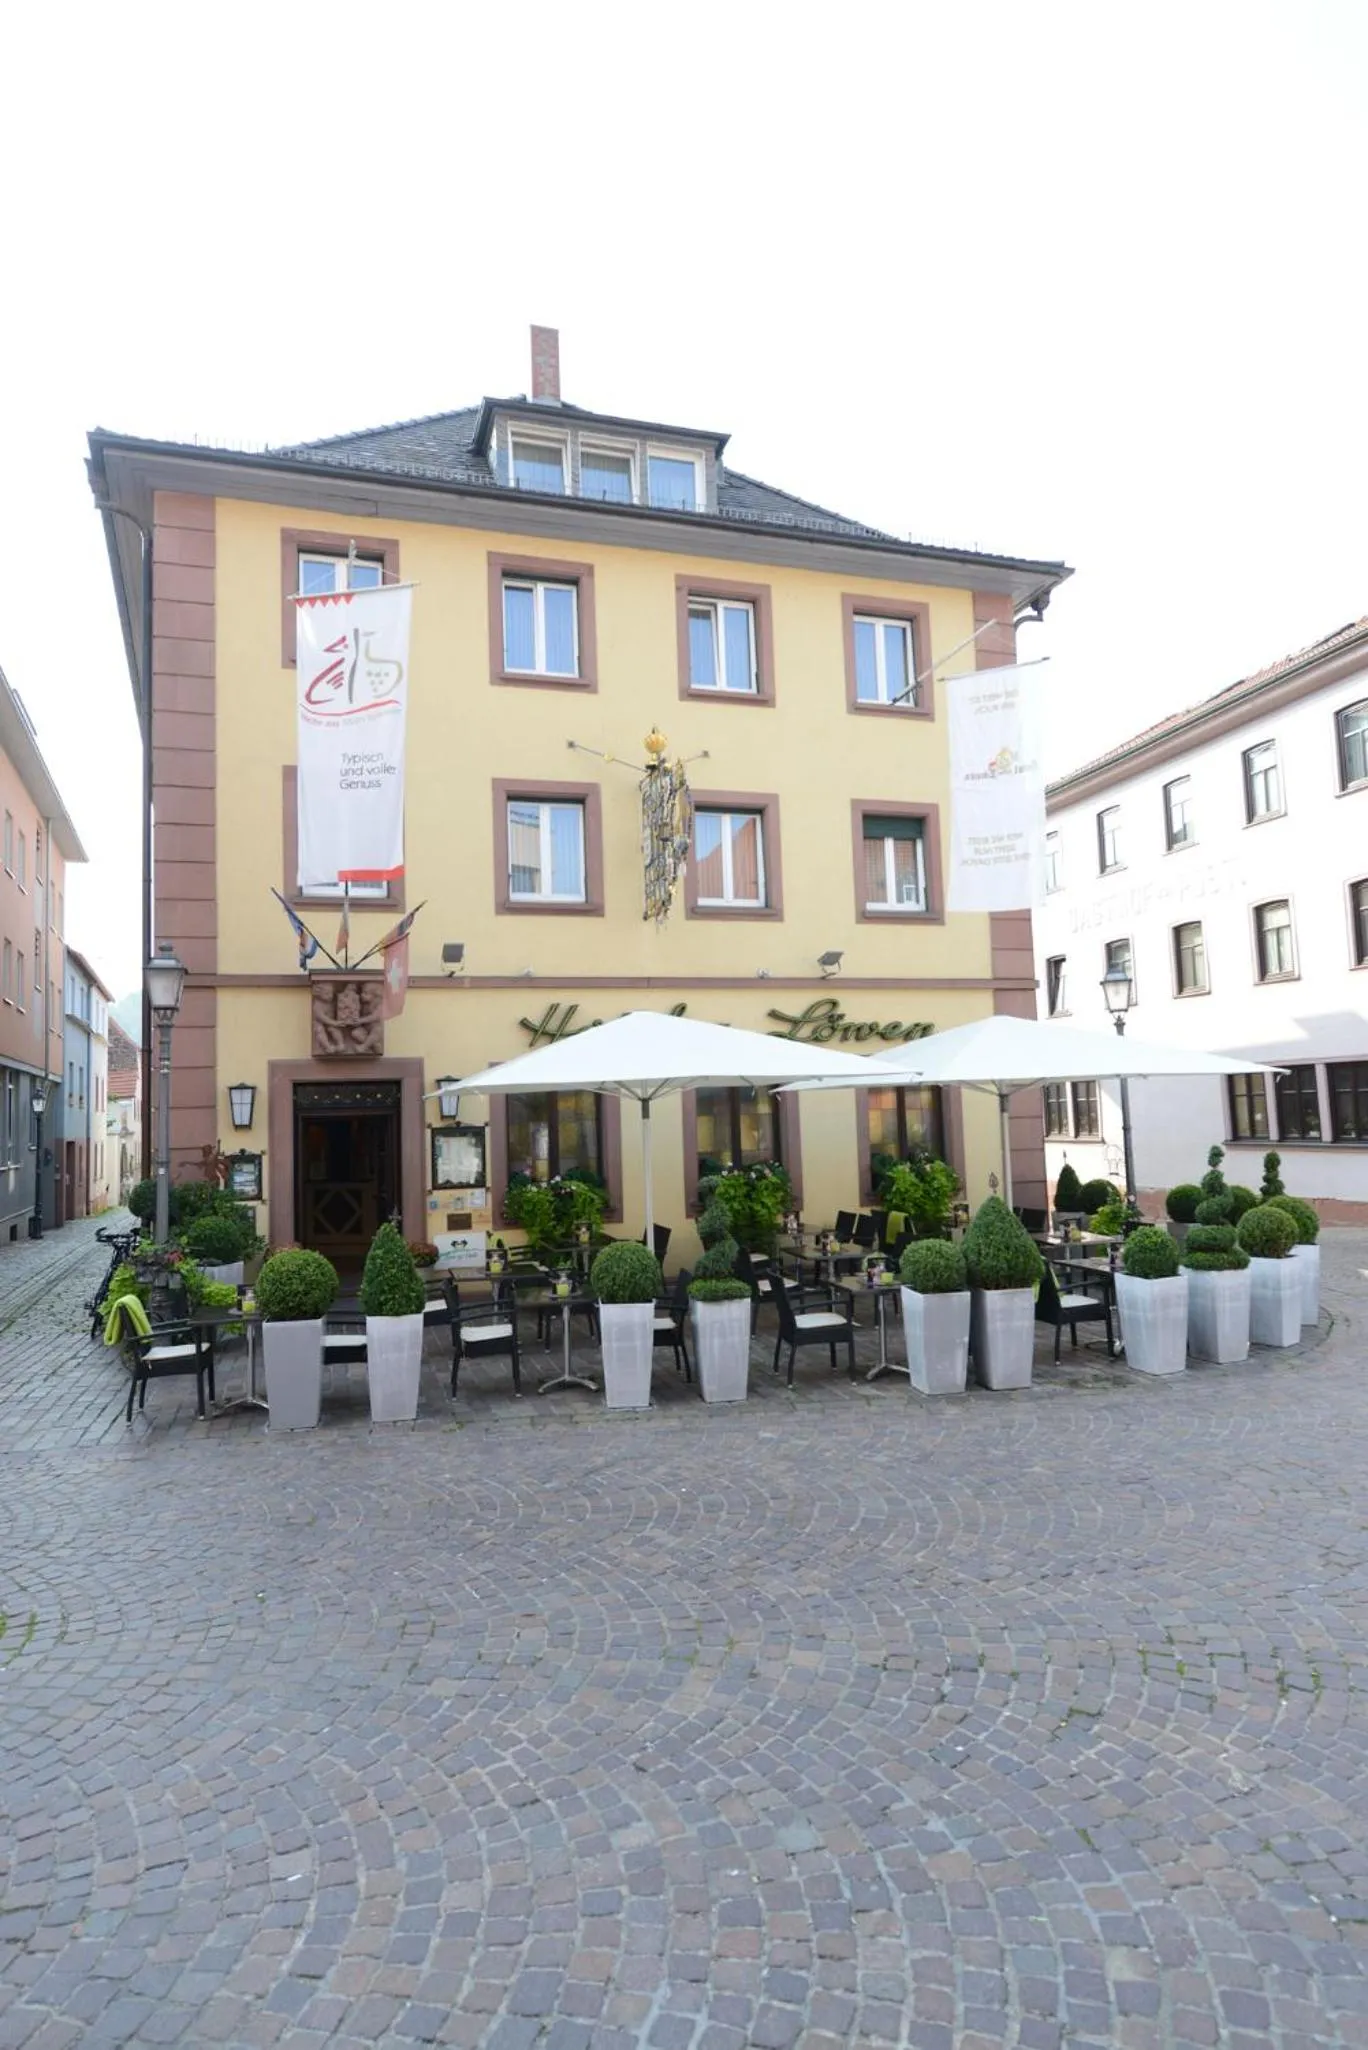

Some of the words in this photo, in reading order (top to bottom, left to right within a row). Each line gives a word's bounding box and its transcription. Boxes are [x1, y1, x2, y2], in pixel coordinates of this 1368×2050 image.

[342, 752, 384, 764] Typisch
[340, 765, 364, 777] und
[340, 778, 382, 790] Genuss
[767, 998, 936, 1043] Löwen
